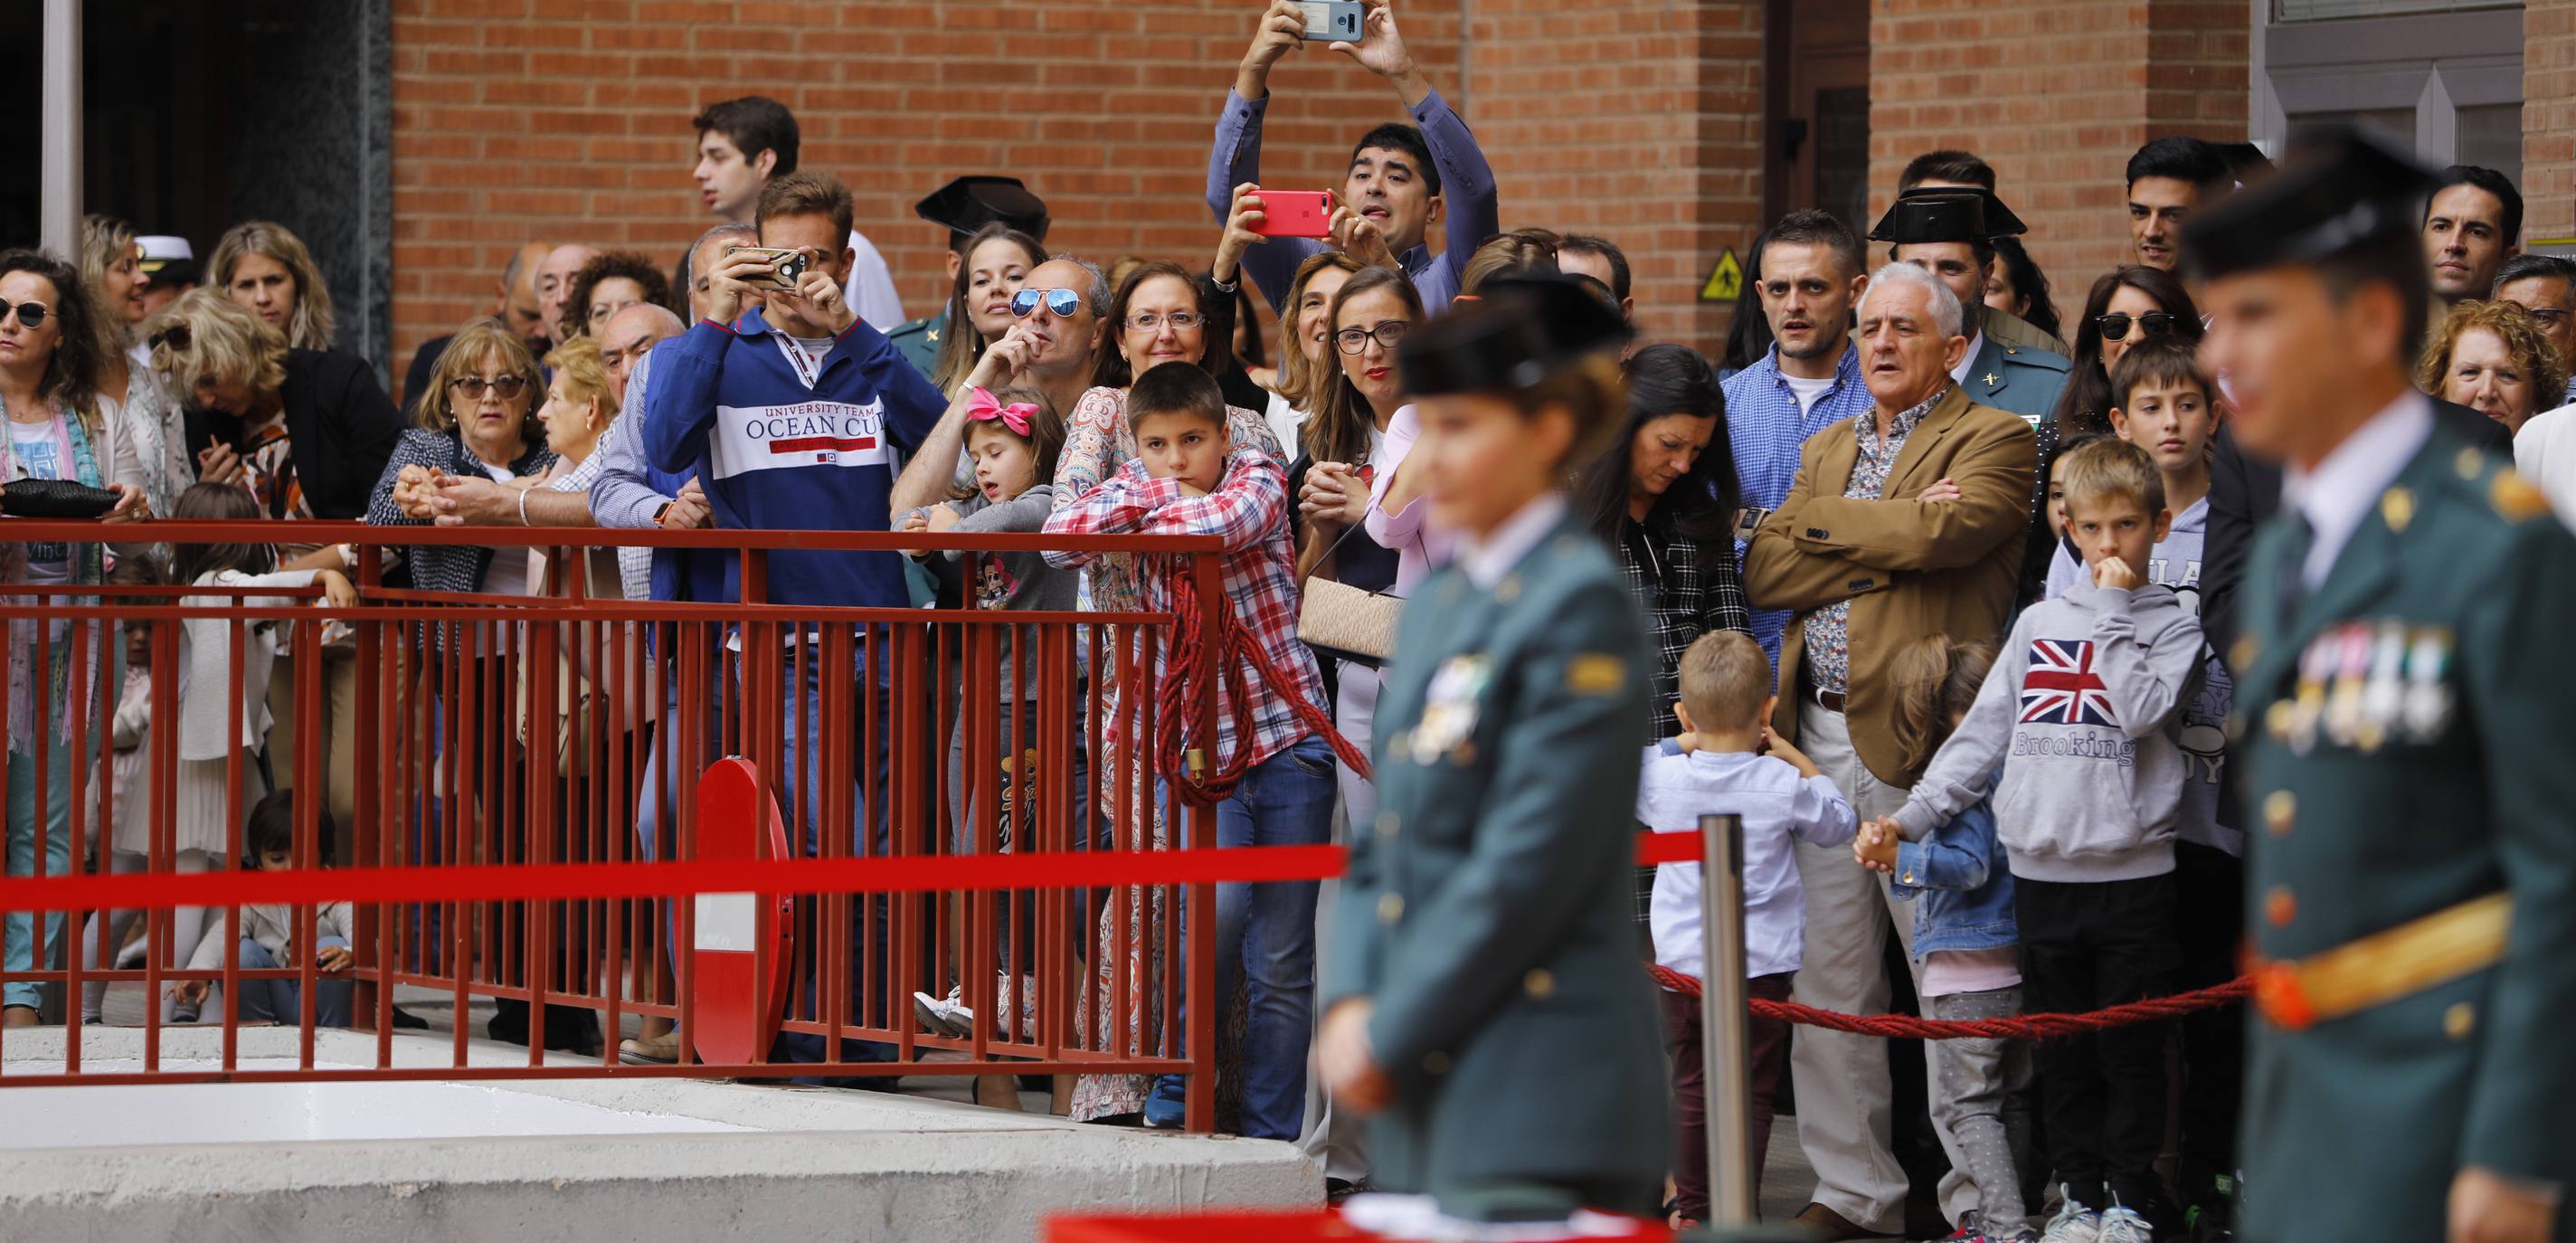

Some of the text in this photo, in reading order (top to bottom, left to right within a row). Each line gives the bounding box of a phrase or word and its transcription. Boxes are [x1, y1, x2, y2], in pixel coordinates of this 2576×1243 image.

[765, 403, 875, 417] UNIVERSITY TEAM
[746, 415, 836, 440] OCEAN
